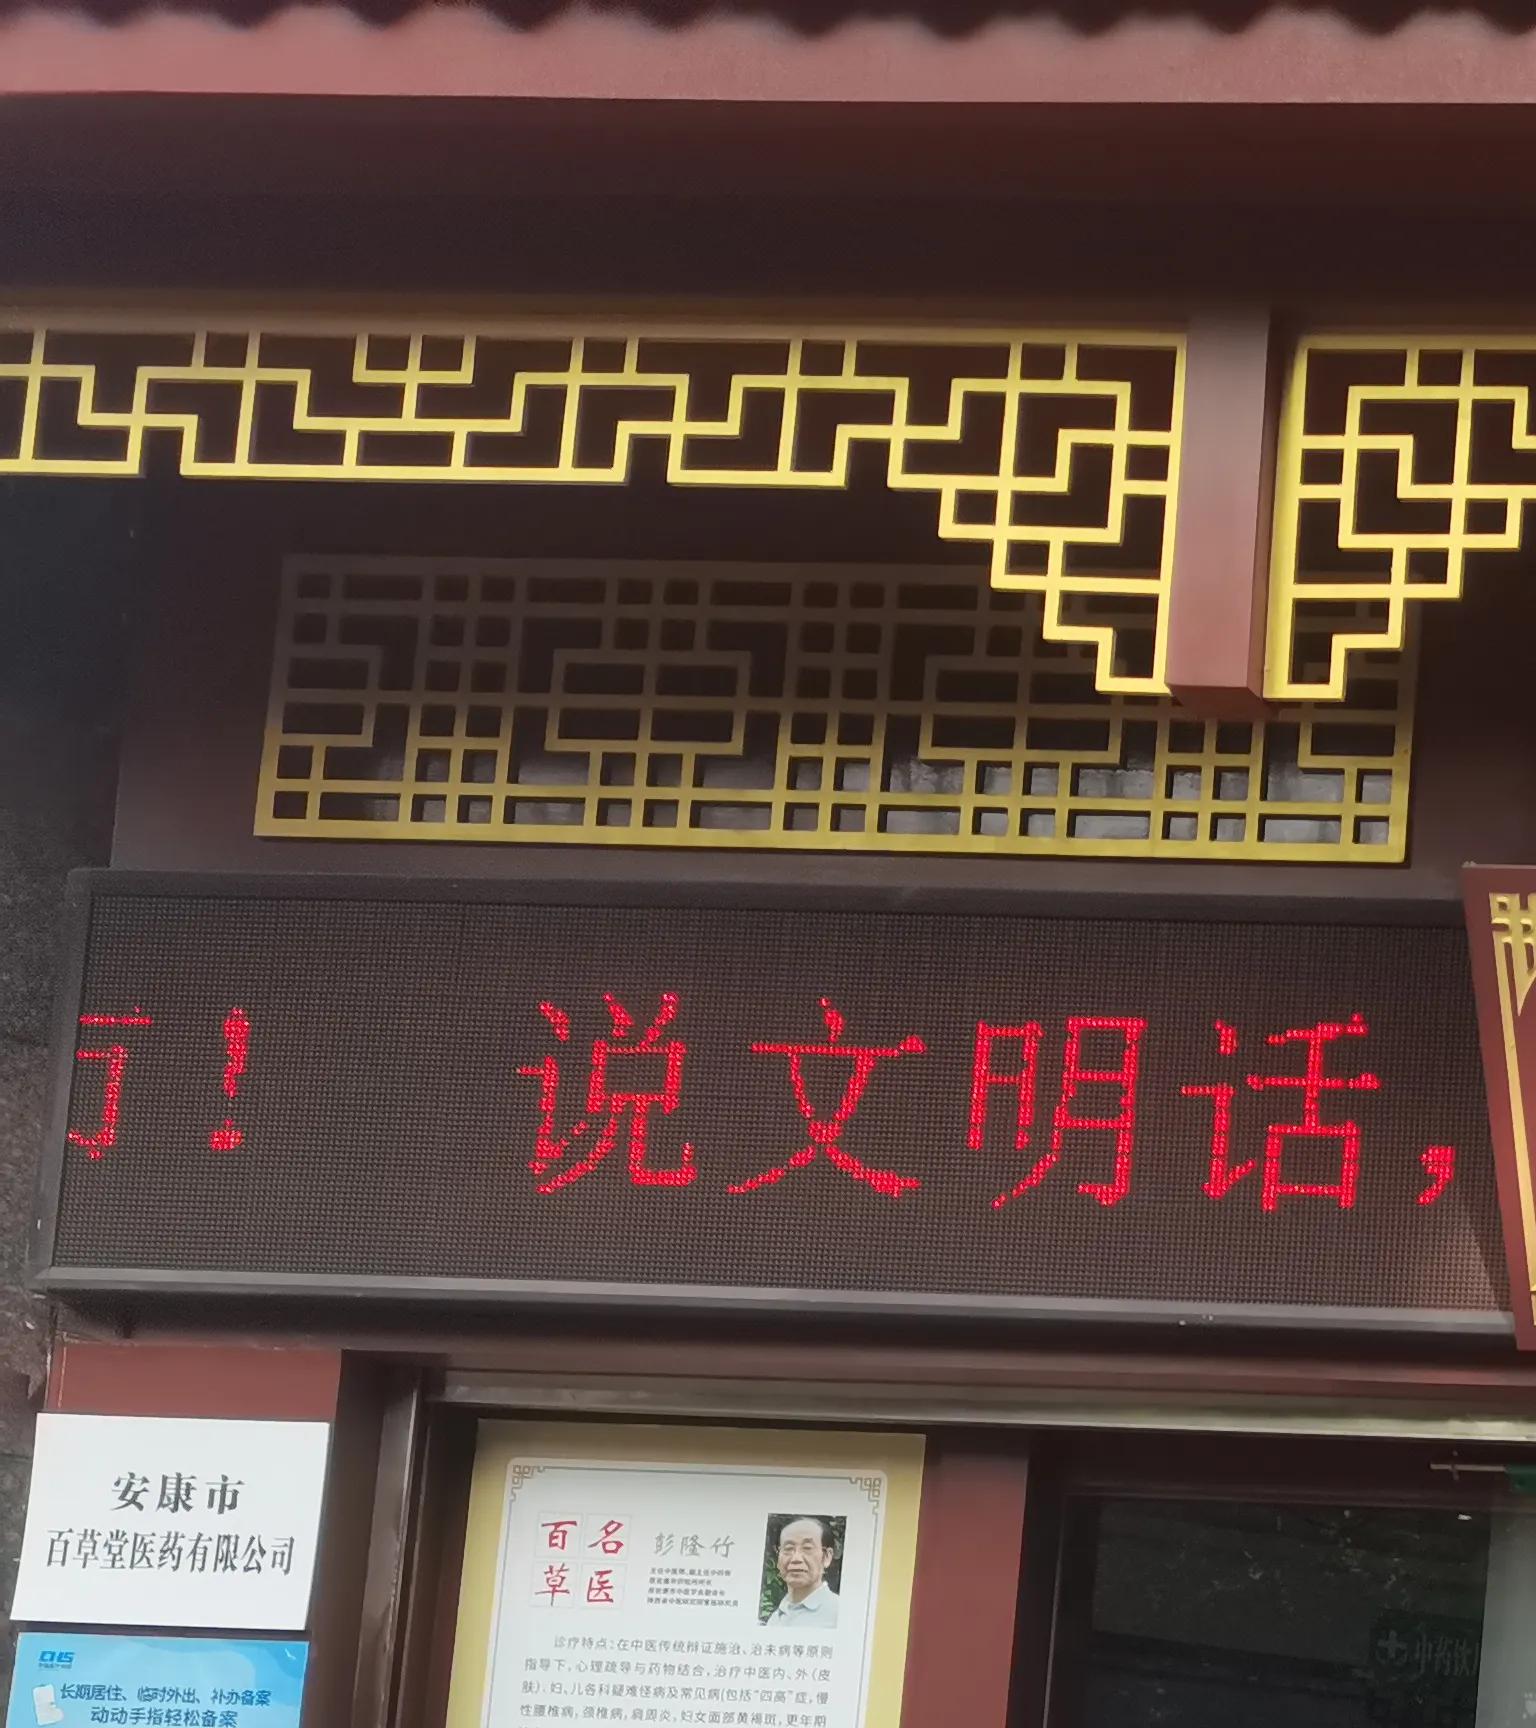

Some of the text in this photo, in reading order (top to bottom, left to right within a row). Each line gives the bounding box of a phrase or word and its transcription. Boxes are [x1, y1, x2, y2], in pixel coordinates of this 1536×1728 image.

[110, 1472, 246, 1516] 安康市
[45, 1526, 297, 1577] 百草堂医药有限公司
[652, 1531, 737, 1559] 彭隆竹
[90, 1706, 239, 1728] 动动手指轻松备案
